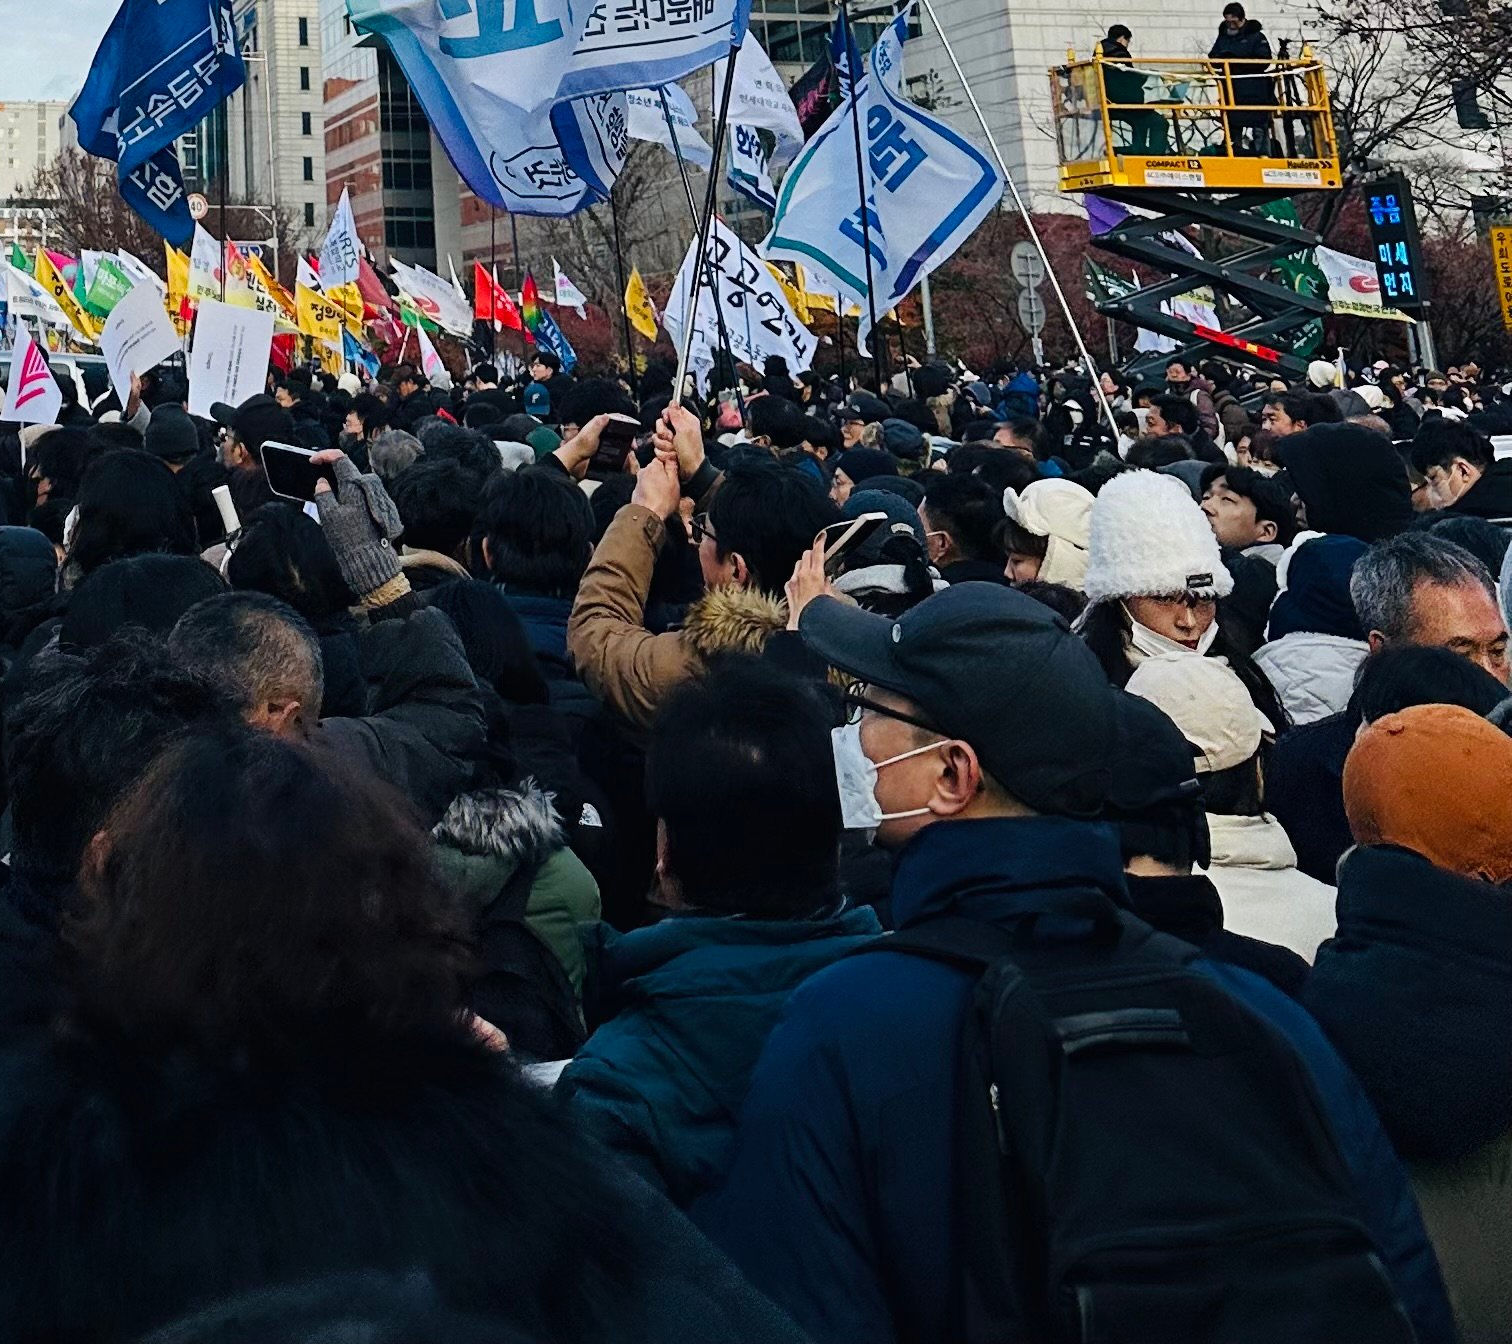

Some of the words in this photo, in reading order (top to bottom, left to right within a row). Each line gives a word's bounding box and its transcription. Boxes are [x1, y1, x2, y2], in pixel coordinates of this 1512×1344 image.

[1146, 160, 1186, 169] COMPACT
[190, 201, 203, 213] 40
[1378, 241, 1408, 267] 미세
[1384, 271, 1414, 297] 먼지
